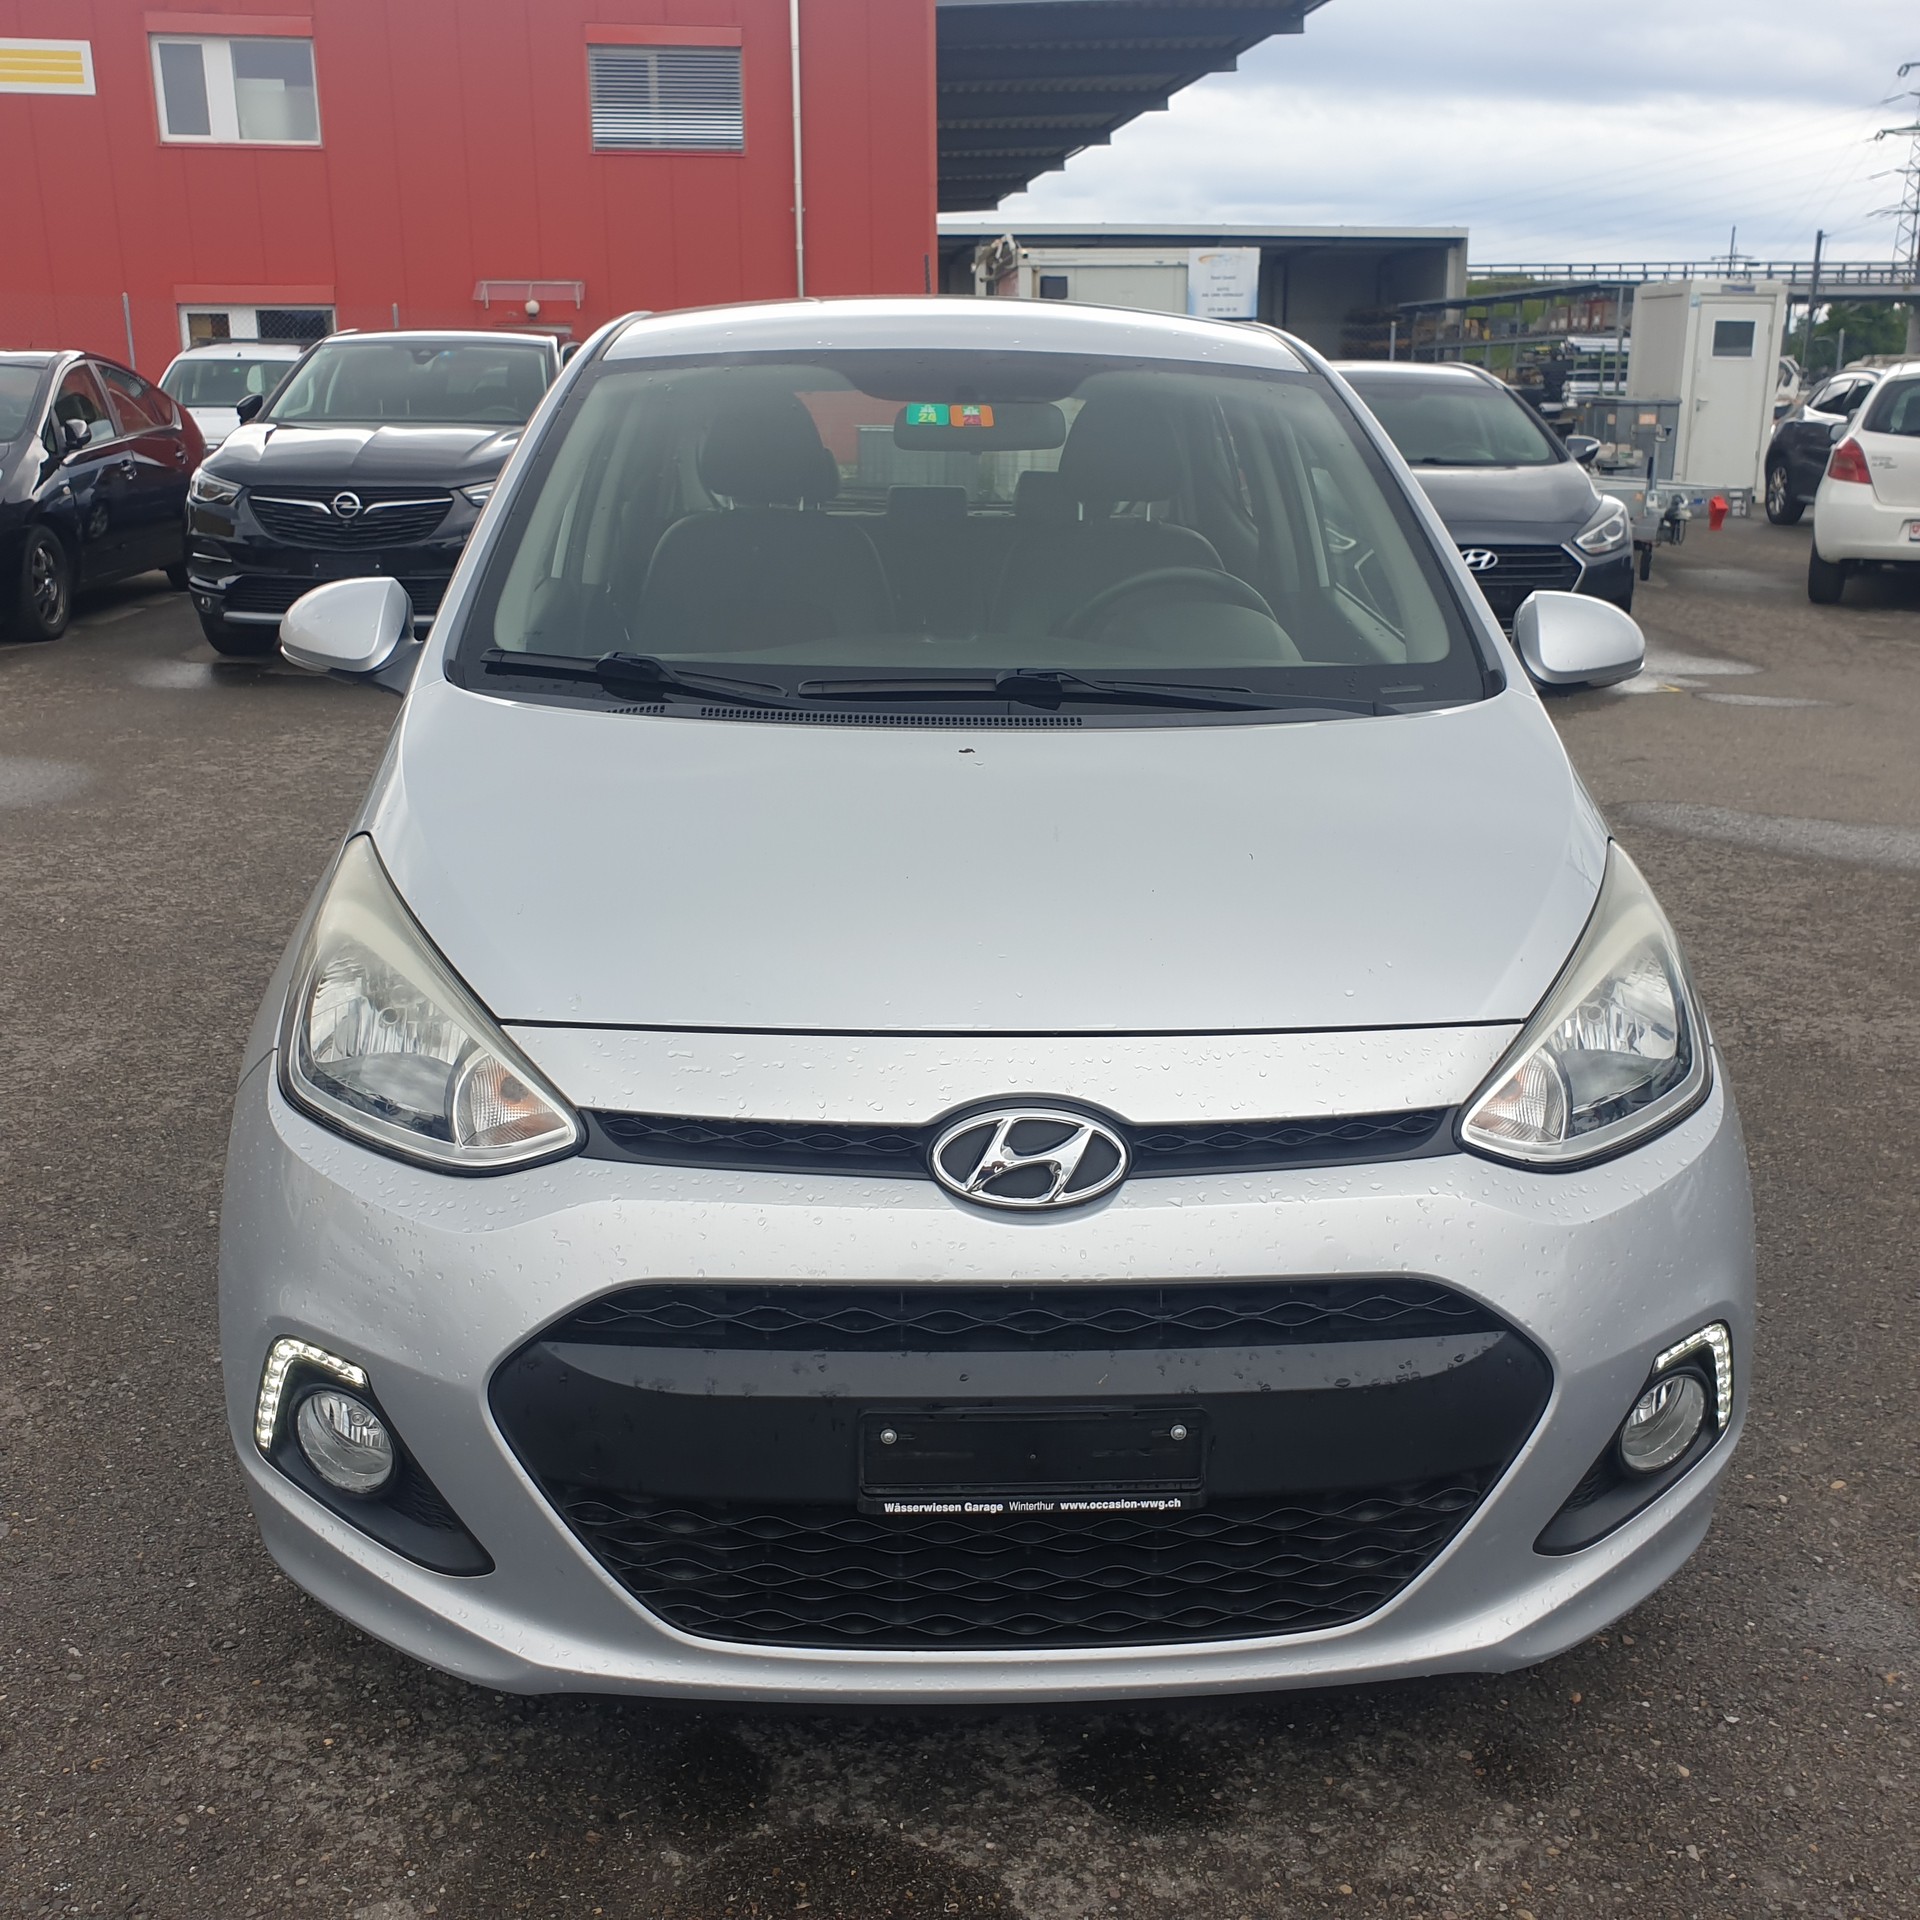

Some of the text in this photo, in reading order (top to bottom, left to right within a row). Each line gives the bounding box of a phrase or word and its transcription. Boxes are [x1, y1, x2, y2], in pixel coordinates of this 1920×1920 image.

[884, 1498, 1181, 1514] Wässerwiesen Garage Winterthur www.occasion-wwg.ch
